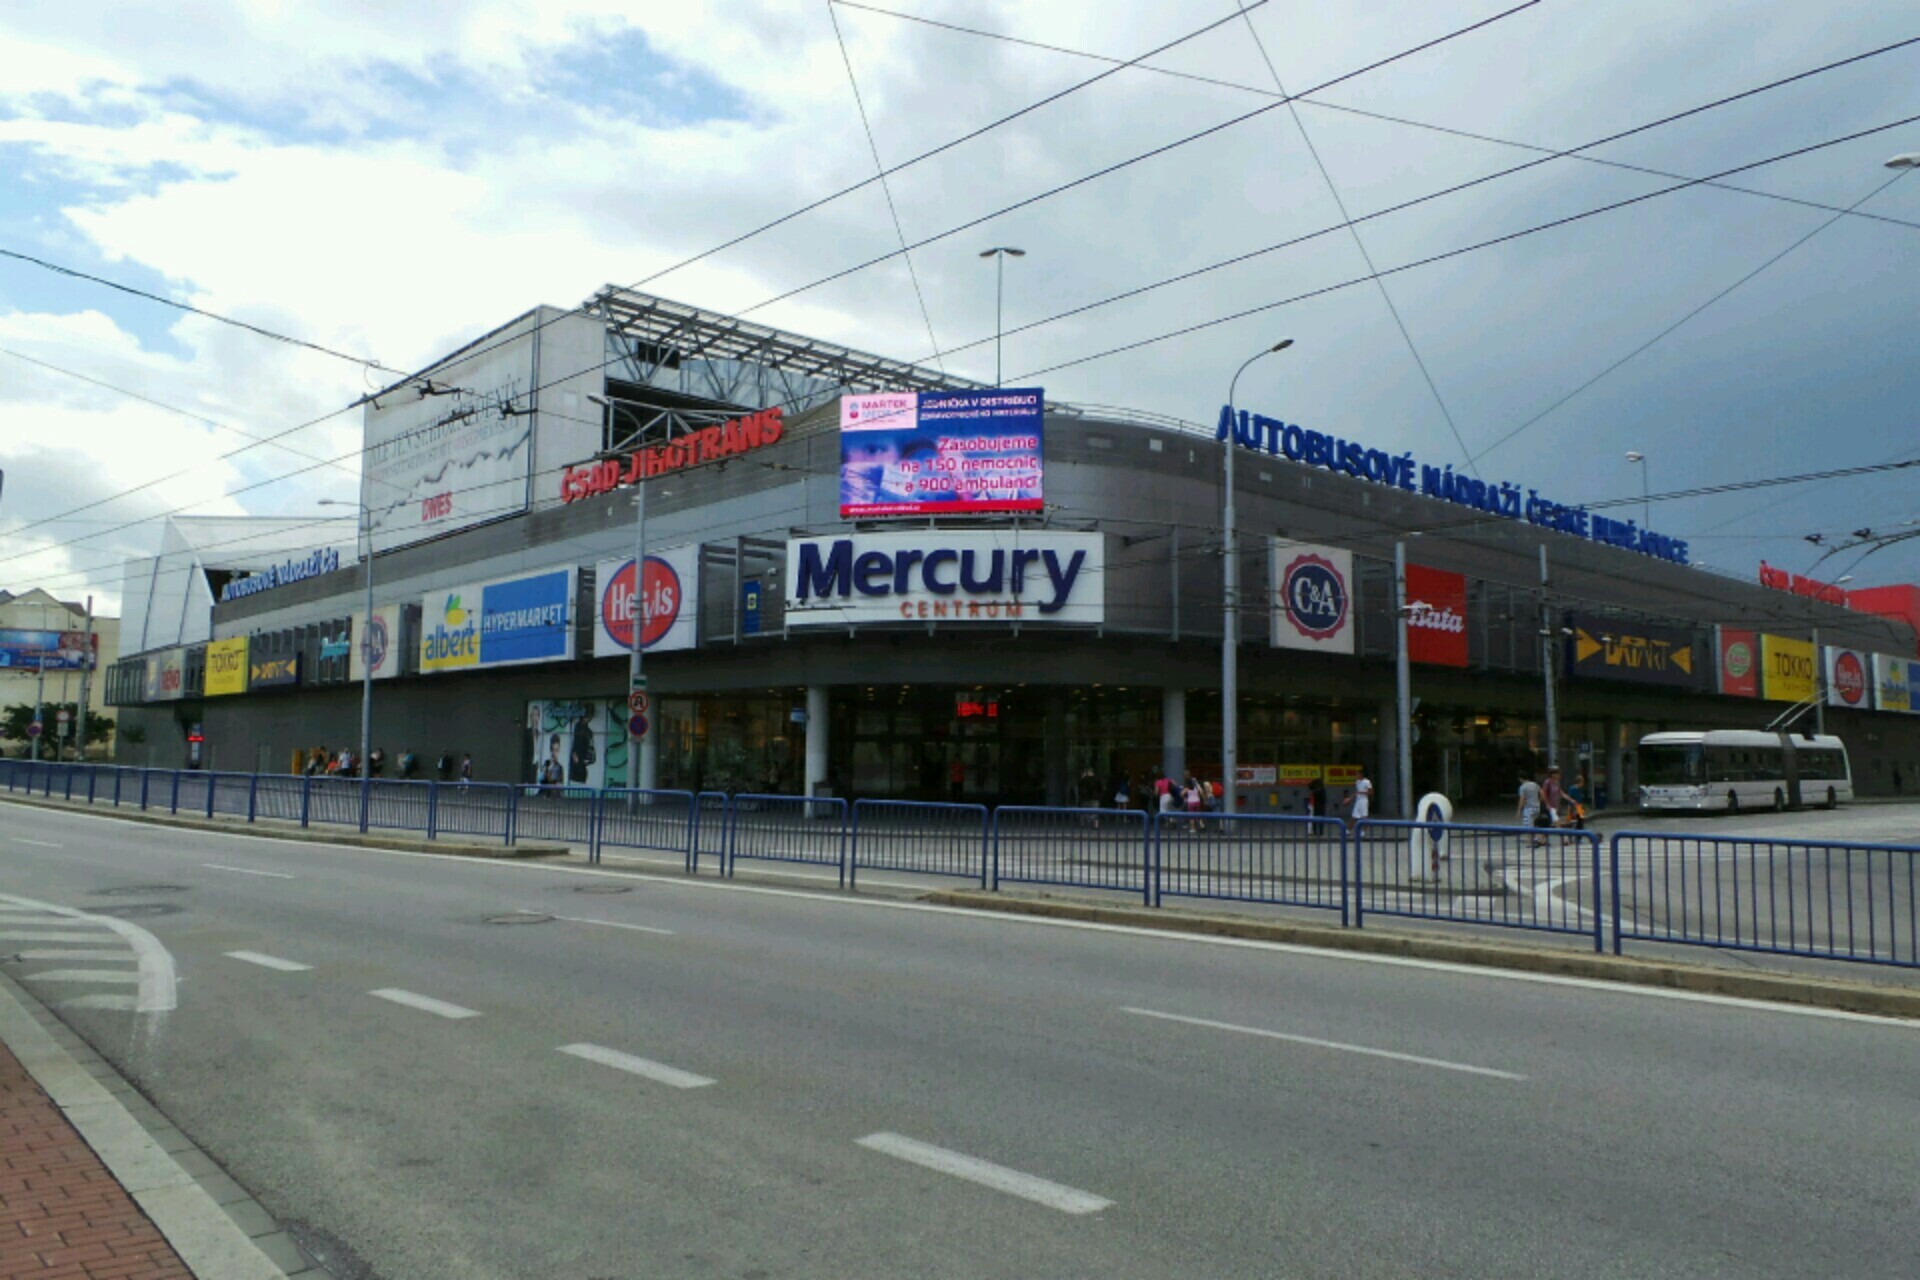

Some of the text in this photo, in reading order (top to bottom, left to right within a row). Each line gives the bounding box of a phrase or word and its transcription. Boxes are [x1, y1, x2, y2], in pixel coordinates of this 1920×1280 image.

[560, 406, 784, 504] ČSAD JIHOTRANS
[938, 436, 1038, 452] Zásobujeme
[1215, 404, 1417, 492] AUTOBUSOVÉ
[1421, 463, 1521, 519] NÁDRAŽÍ
[901, 456, 1038, 472] na 150 nemocnic
[905, 484, 914, 492] a
[919, 478, 951, 491] 900
[796, 539, 1087, 614] Mercury
[899, 600, 1024, 618] CENTRUM
[1294, 577, 1338, 617] C&A
[484, 603, 563, 633] HYPERMARKET
[425, 620, 475, 660] albert
